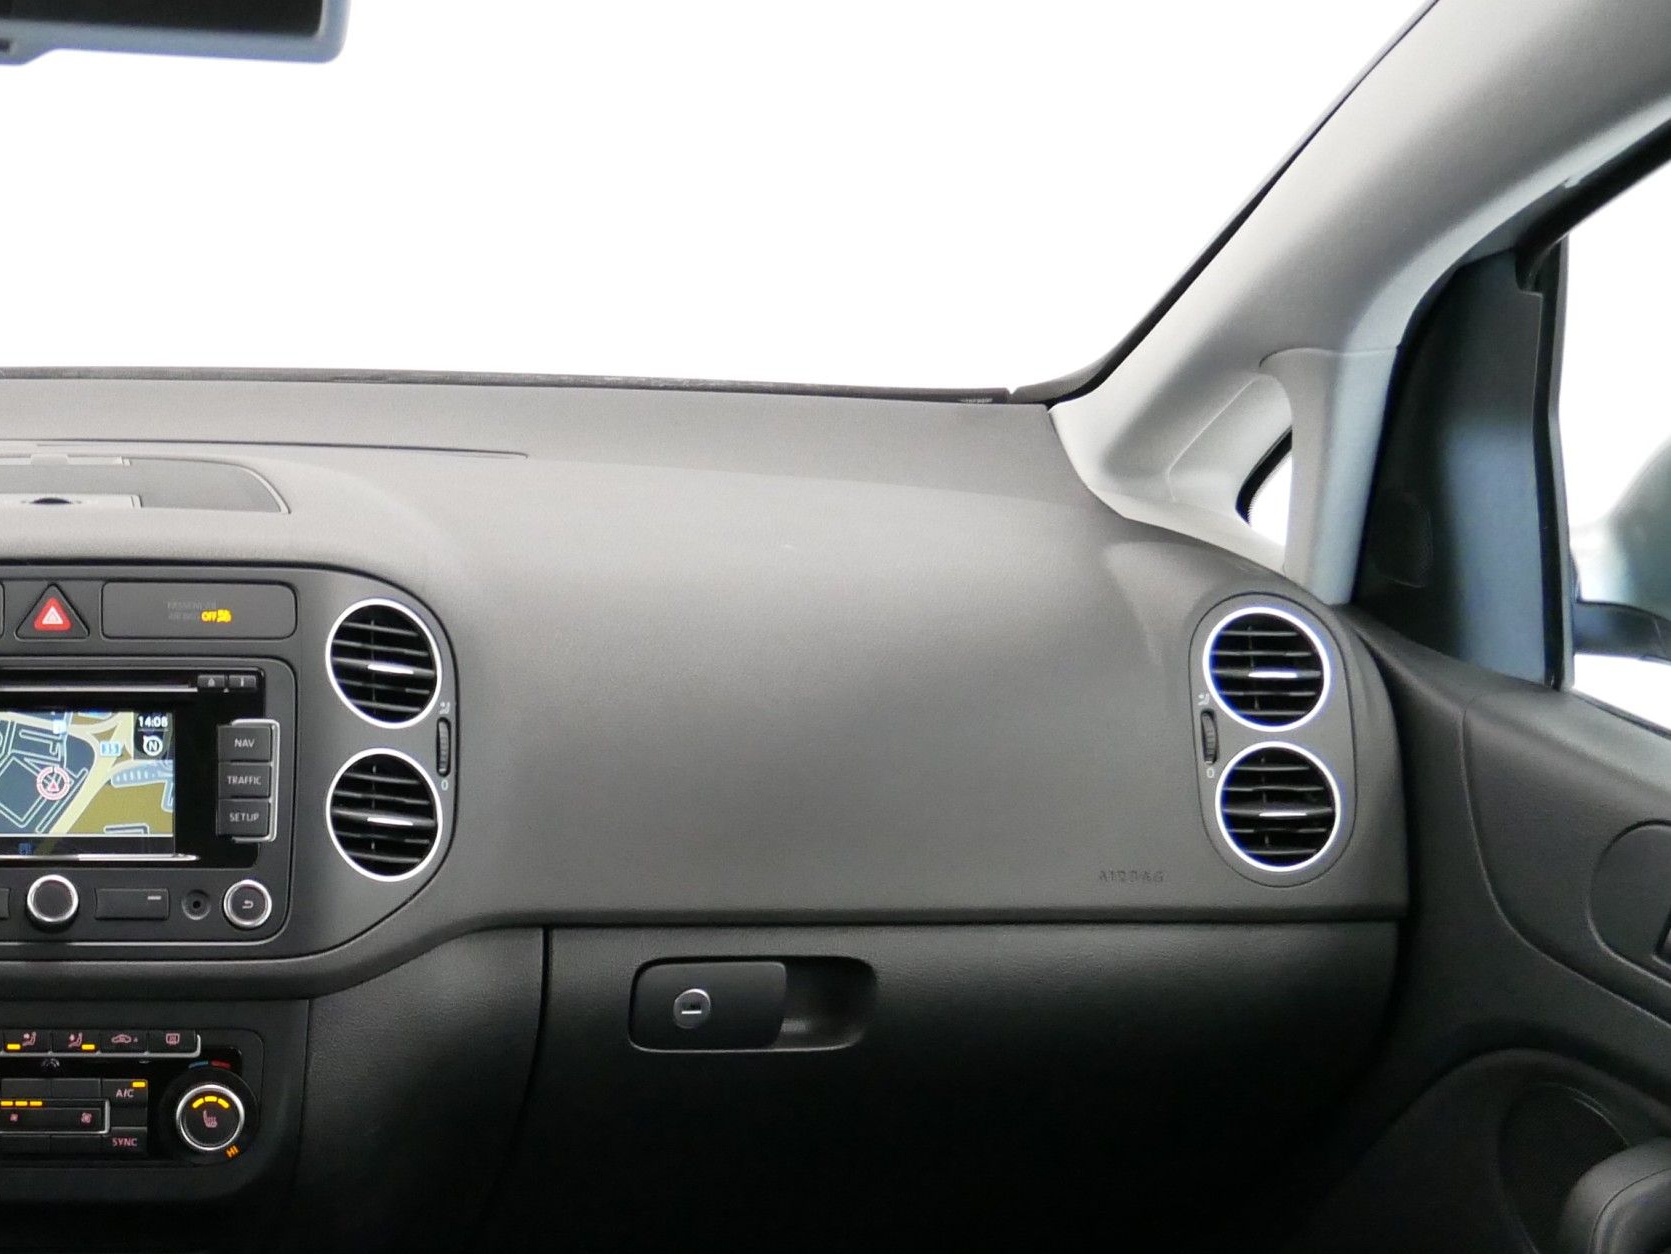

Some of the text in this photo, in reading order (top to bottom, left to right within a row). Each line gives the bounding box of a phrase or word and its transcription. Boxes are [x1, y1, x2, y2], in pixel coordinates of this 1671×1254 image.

[234, 738, 255, 748] NAV
[227, 776, 261, 785] TRAFFIC
[230, 813, 260, 822] SETUP
[116, 1088, 134, 1098] A/C
[112, 1137, 138, 1147] SYNC
